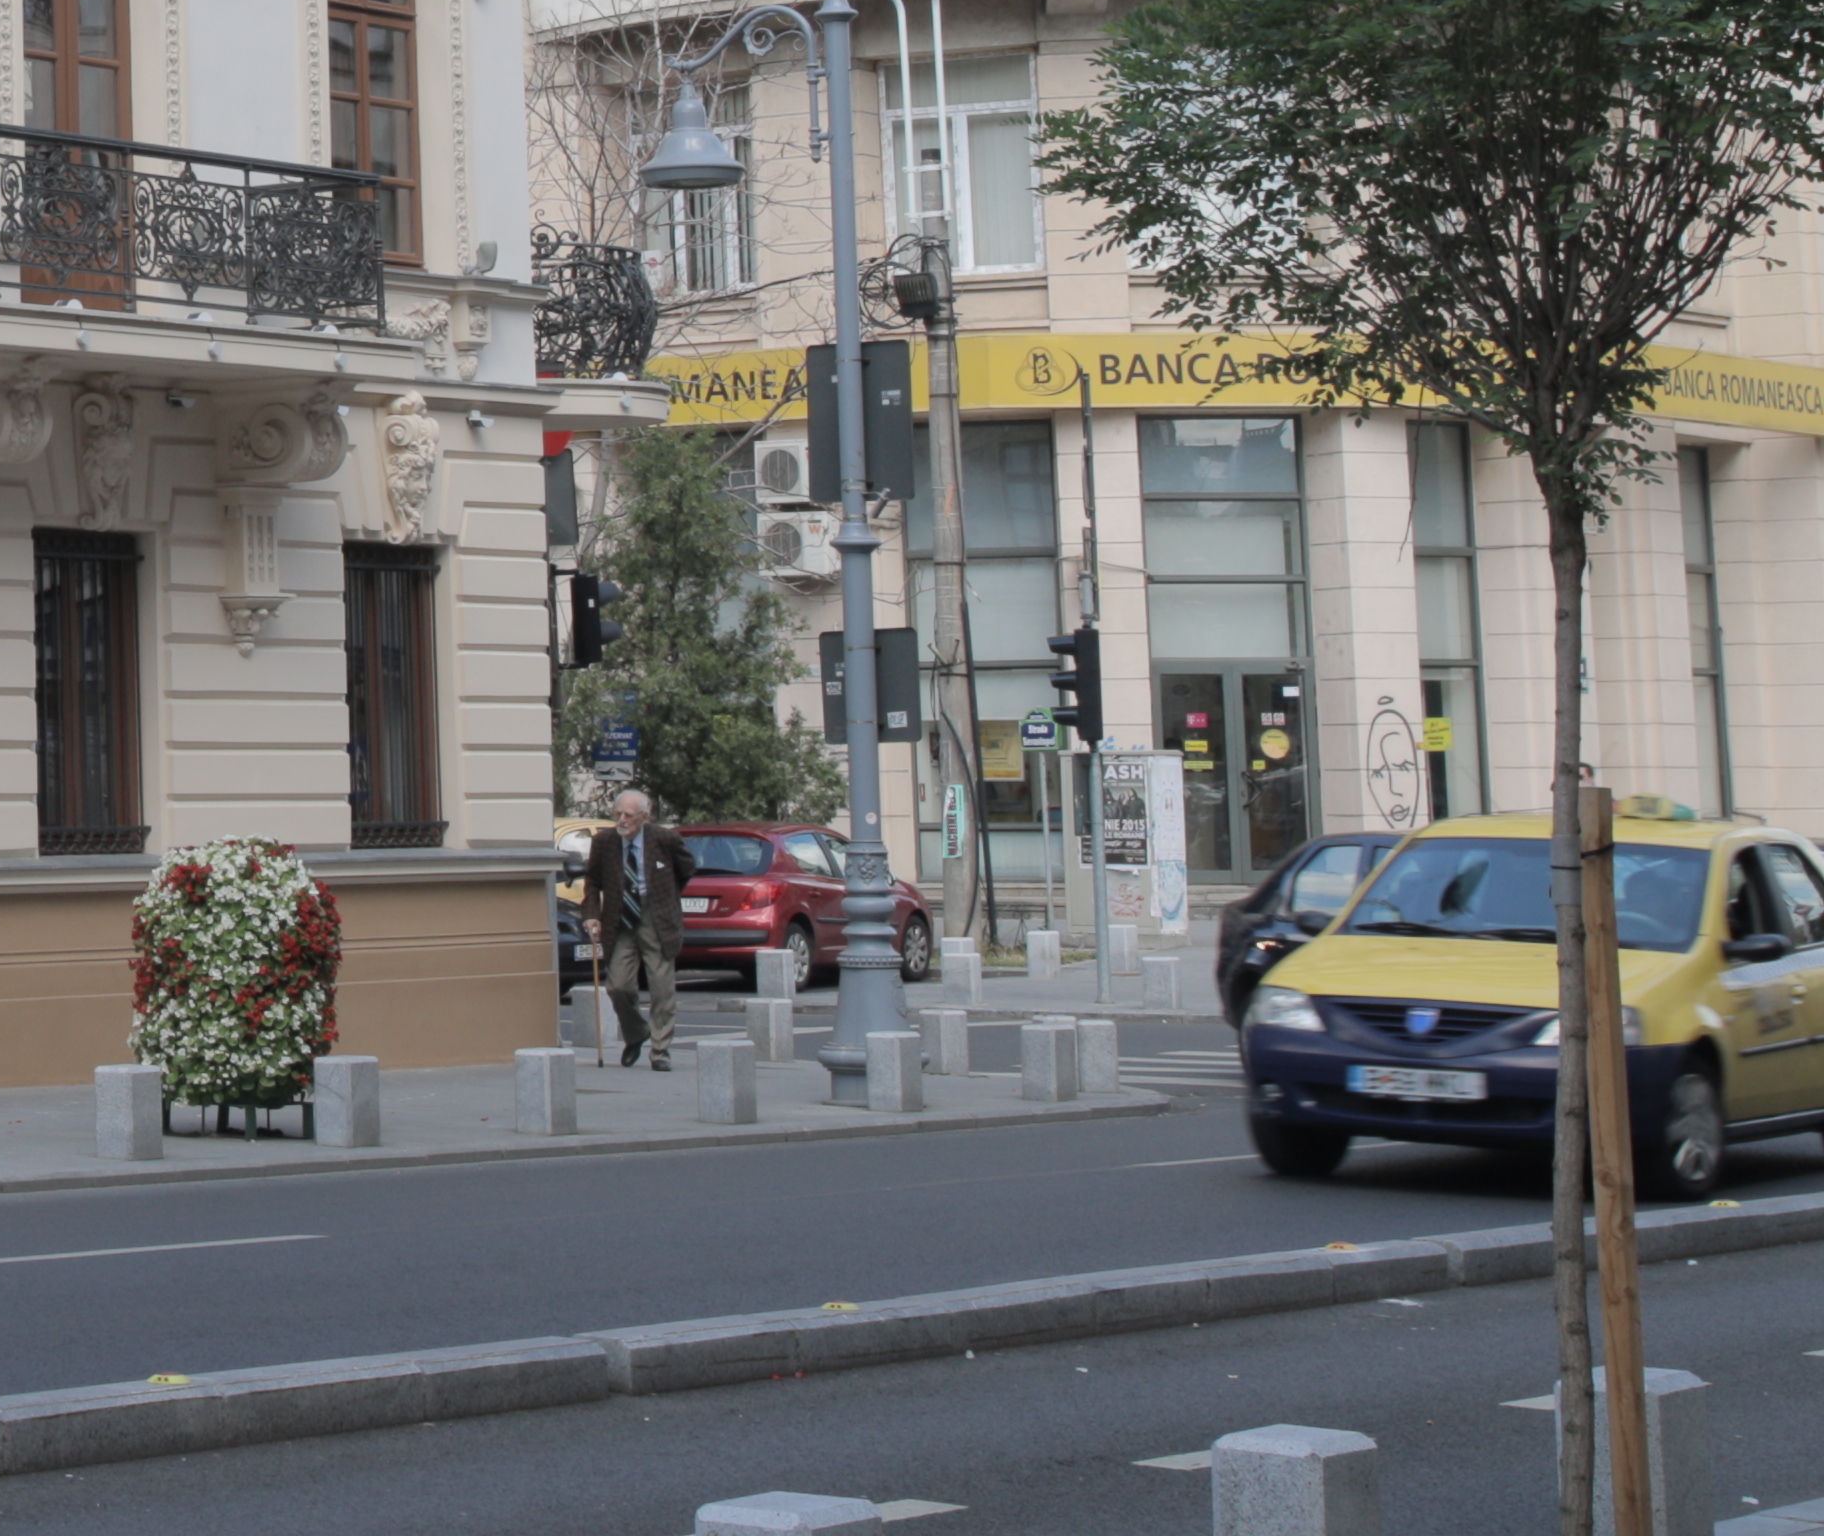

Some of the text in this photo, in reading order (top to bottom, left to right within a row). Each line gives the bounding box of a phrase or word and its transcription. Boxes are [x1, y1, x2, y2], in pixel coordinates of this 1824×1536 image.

[1099, 353, 1242, 386] BANCA
[670, 368, 808, 405] MANEA
[1663, 367, 1824, 415] BANCA ROMANEASCA
[1104, 764, 1144, 780] ASH
[1104, 819, 1146, 832] NIE 2015
[684, 898, 706, 909] UXU
